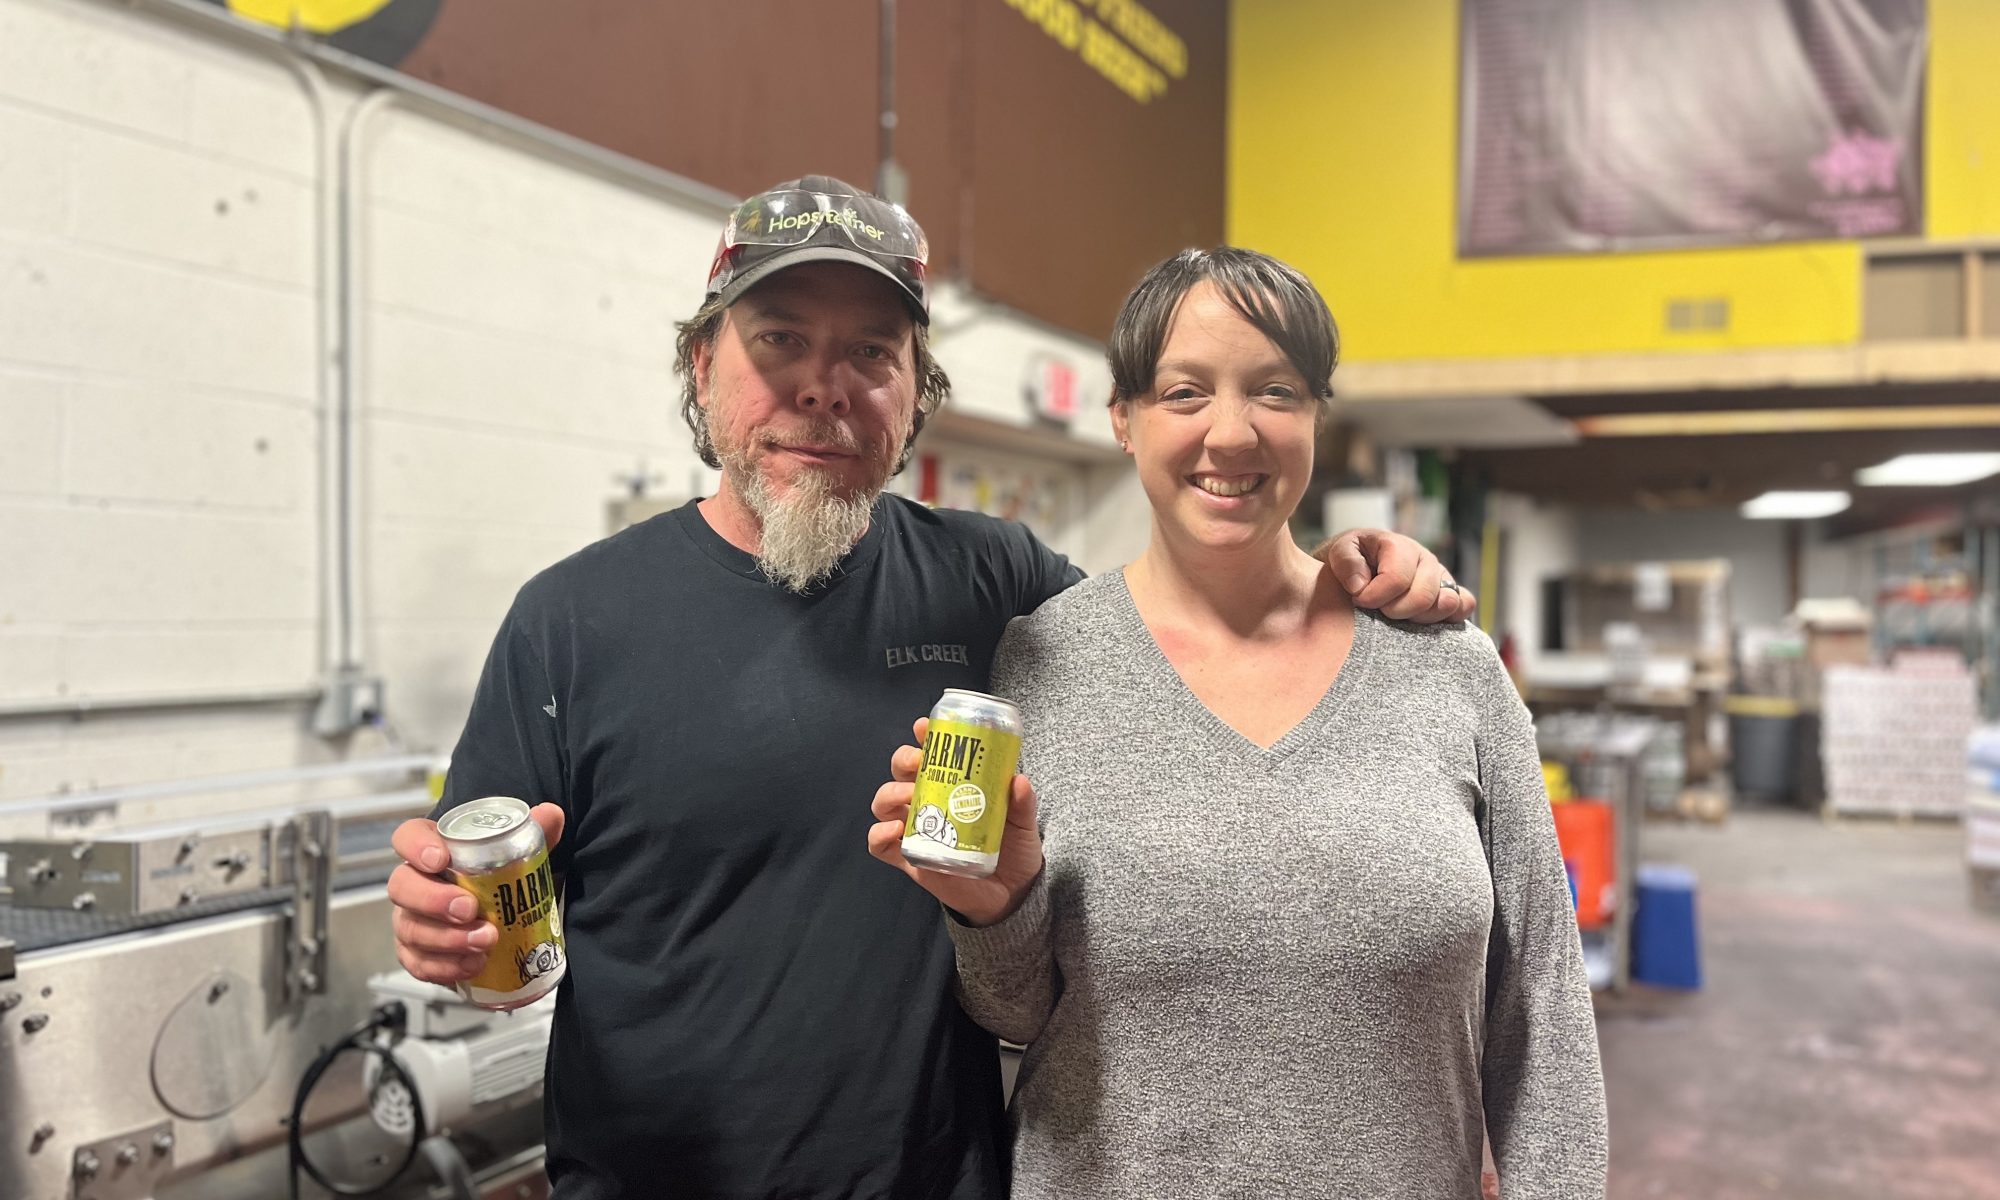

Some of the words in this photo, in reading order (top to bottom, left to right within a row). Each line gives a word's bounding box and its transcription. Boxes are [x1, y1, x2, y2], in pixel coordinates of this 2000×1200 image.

[768, 208, 885, 241] Hopsteiner
[886, 645, 920, 668] ELK
[921, 643, 969, 666] CREEK
[921, 731, 981, 780] BARMY
[927, 768, 945, 783] SODA
[521, 907, 543, 928] SODA
